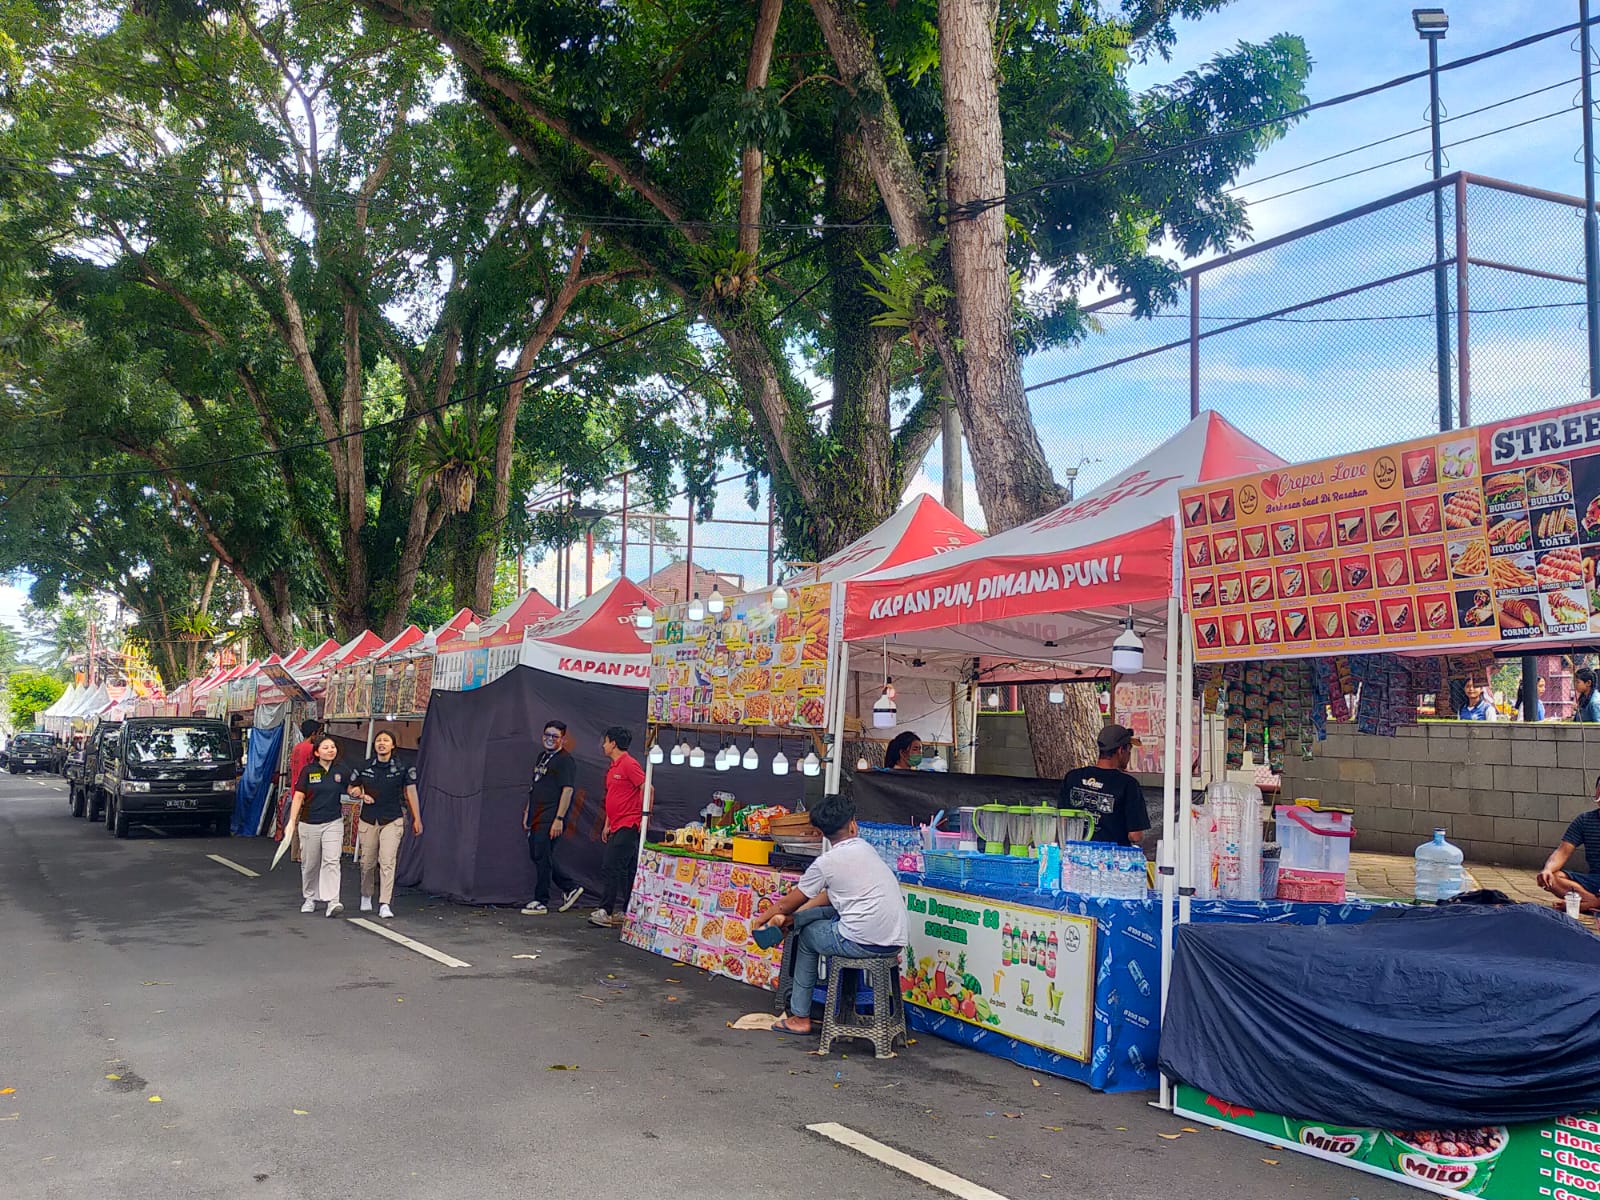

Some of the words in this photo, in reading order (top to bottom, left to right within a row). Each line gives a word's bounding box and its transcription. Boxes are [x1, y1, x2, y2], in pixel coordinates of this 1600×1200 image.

[1494, 411, 1600, 460] STREE
[1277, 472, 1325, 499] Crepes
[1330, 461, 1368, 482] Love
[1265, 499, 1301, 514] Berkesan
[1302, 497, 1319, 507] Saat
[1320, 493, 1331, 504] Di
[1332, 489, 1369, 502] Rasakan
[1489, 501, 1523, 513] BURGER
[1530, 492, 1570, 506] BURRITO
[1491, 542, 1528, 554] HOTDOG
[1540, 536, 1571, 548] TOATS
[869, 589, 931, 620] KAPAN
[932, 581, 974, 609] PUN,
[975, 566, 1060, 602] DIMANA
[1062, 557, 1109, 590] PUN
[1495, 588, 1520, 597] FRENCH
[1520, 585, 1538, 594] FRIES
[1561, 579, 1584, 589] JUMBO
[1502, 626, 1540, 637] CORNDOG
[1547, 622, 1587, 634] HOTTANG
[557, 656, 622, 676] KAPAN
[622, 664, 651, 679] PU
[907, 893, 927, 914] Kas
[928, 897, 981, 926] Denpasar
[924, 920, 968, 945] SEGER
[1305, 1131, 1356, 1154] MILO
[1406, 1157, 1469, 1183] MILO
